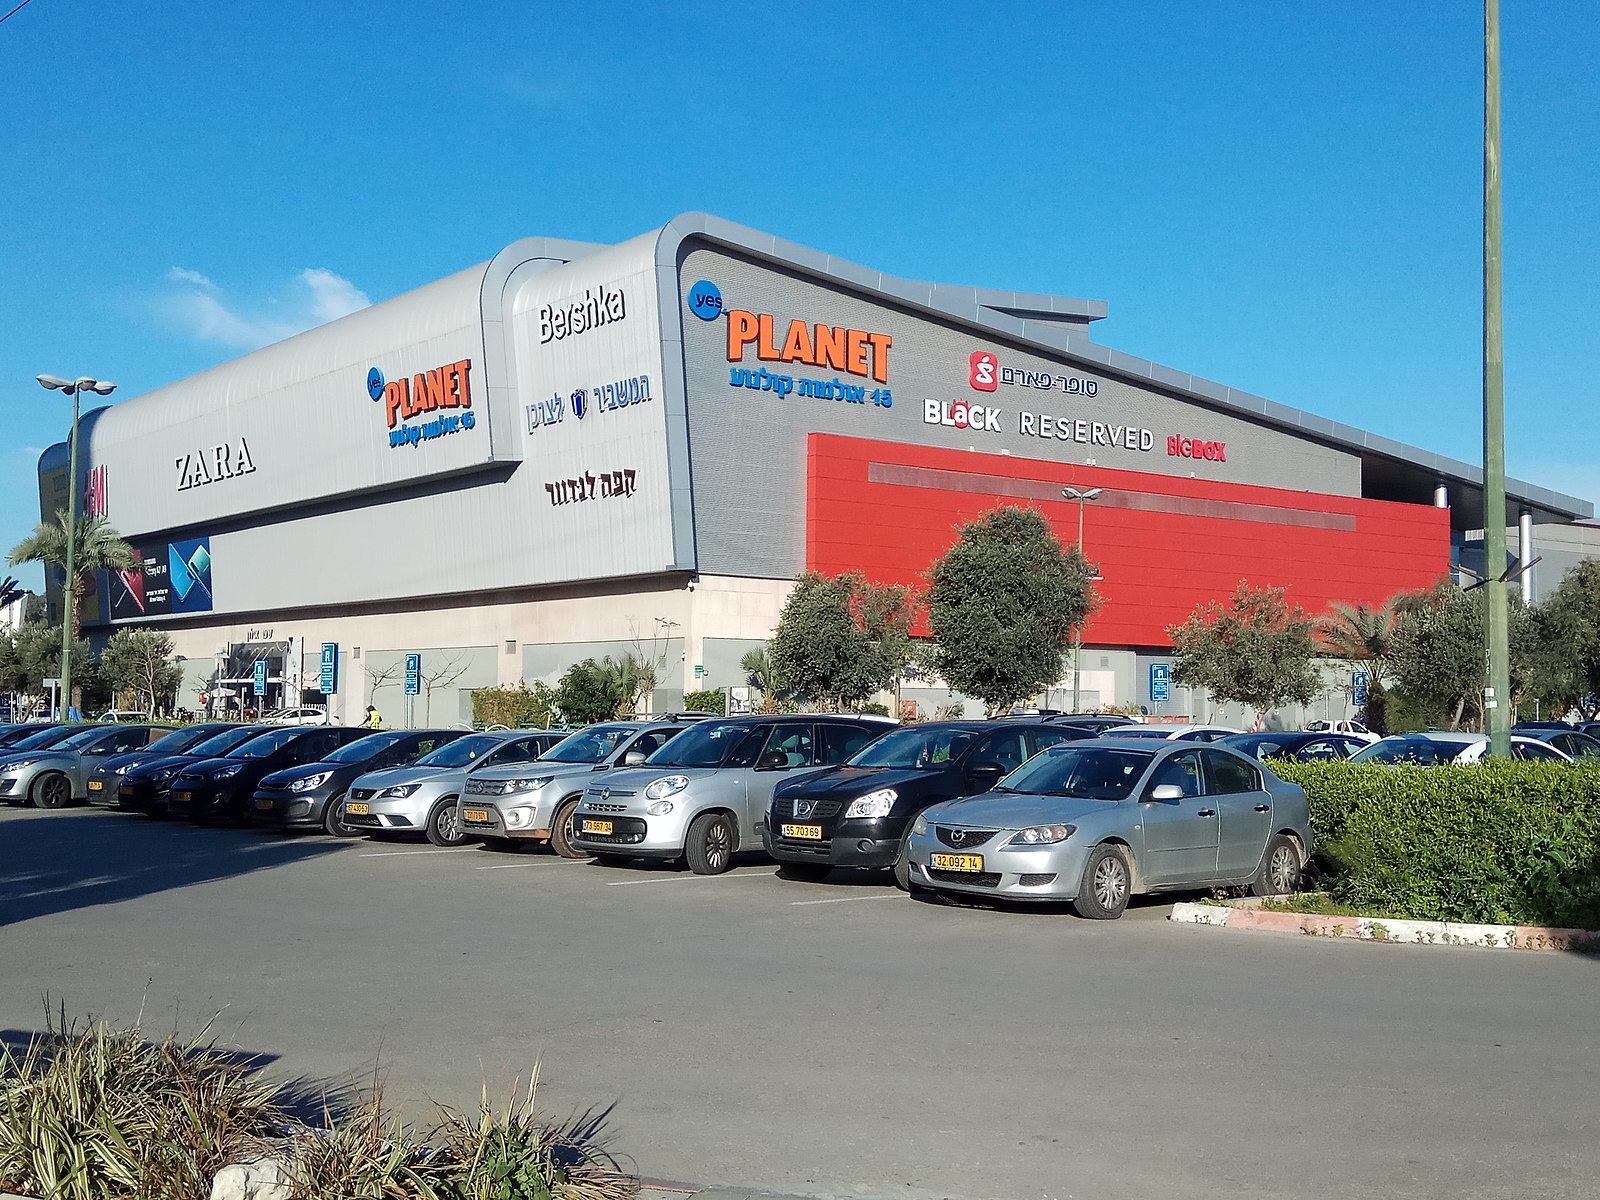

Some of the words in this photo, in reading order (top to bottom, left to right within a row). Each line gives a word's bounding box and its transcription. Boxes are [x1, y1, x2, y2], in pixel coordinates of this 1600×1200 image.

[540, 285, 626, 345] Bershka
[696, 292, 722, 308] yes
[727, 309, 892, 384] PLANET
[369, 377, 381, 393] yes
[384, 359, 472, 429] PLANET
[593, 375, 653, 413] המשביר
[729, 367, 794, 399] קולנוע
[797, 377, 865, 405] אולמות
[870, 388, 893, 408] 15
[526, 392, 565, 435] לצרכן
[1019, 411, 1154, 450] RESERVED
[175, 436, 256, 492] ZARA
[545, 470, 596, 506] לנדוור
[599, 469, 637, 498] קפה
